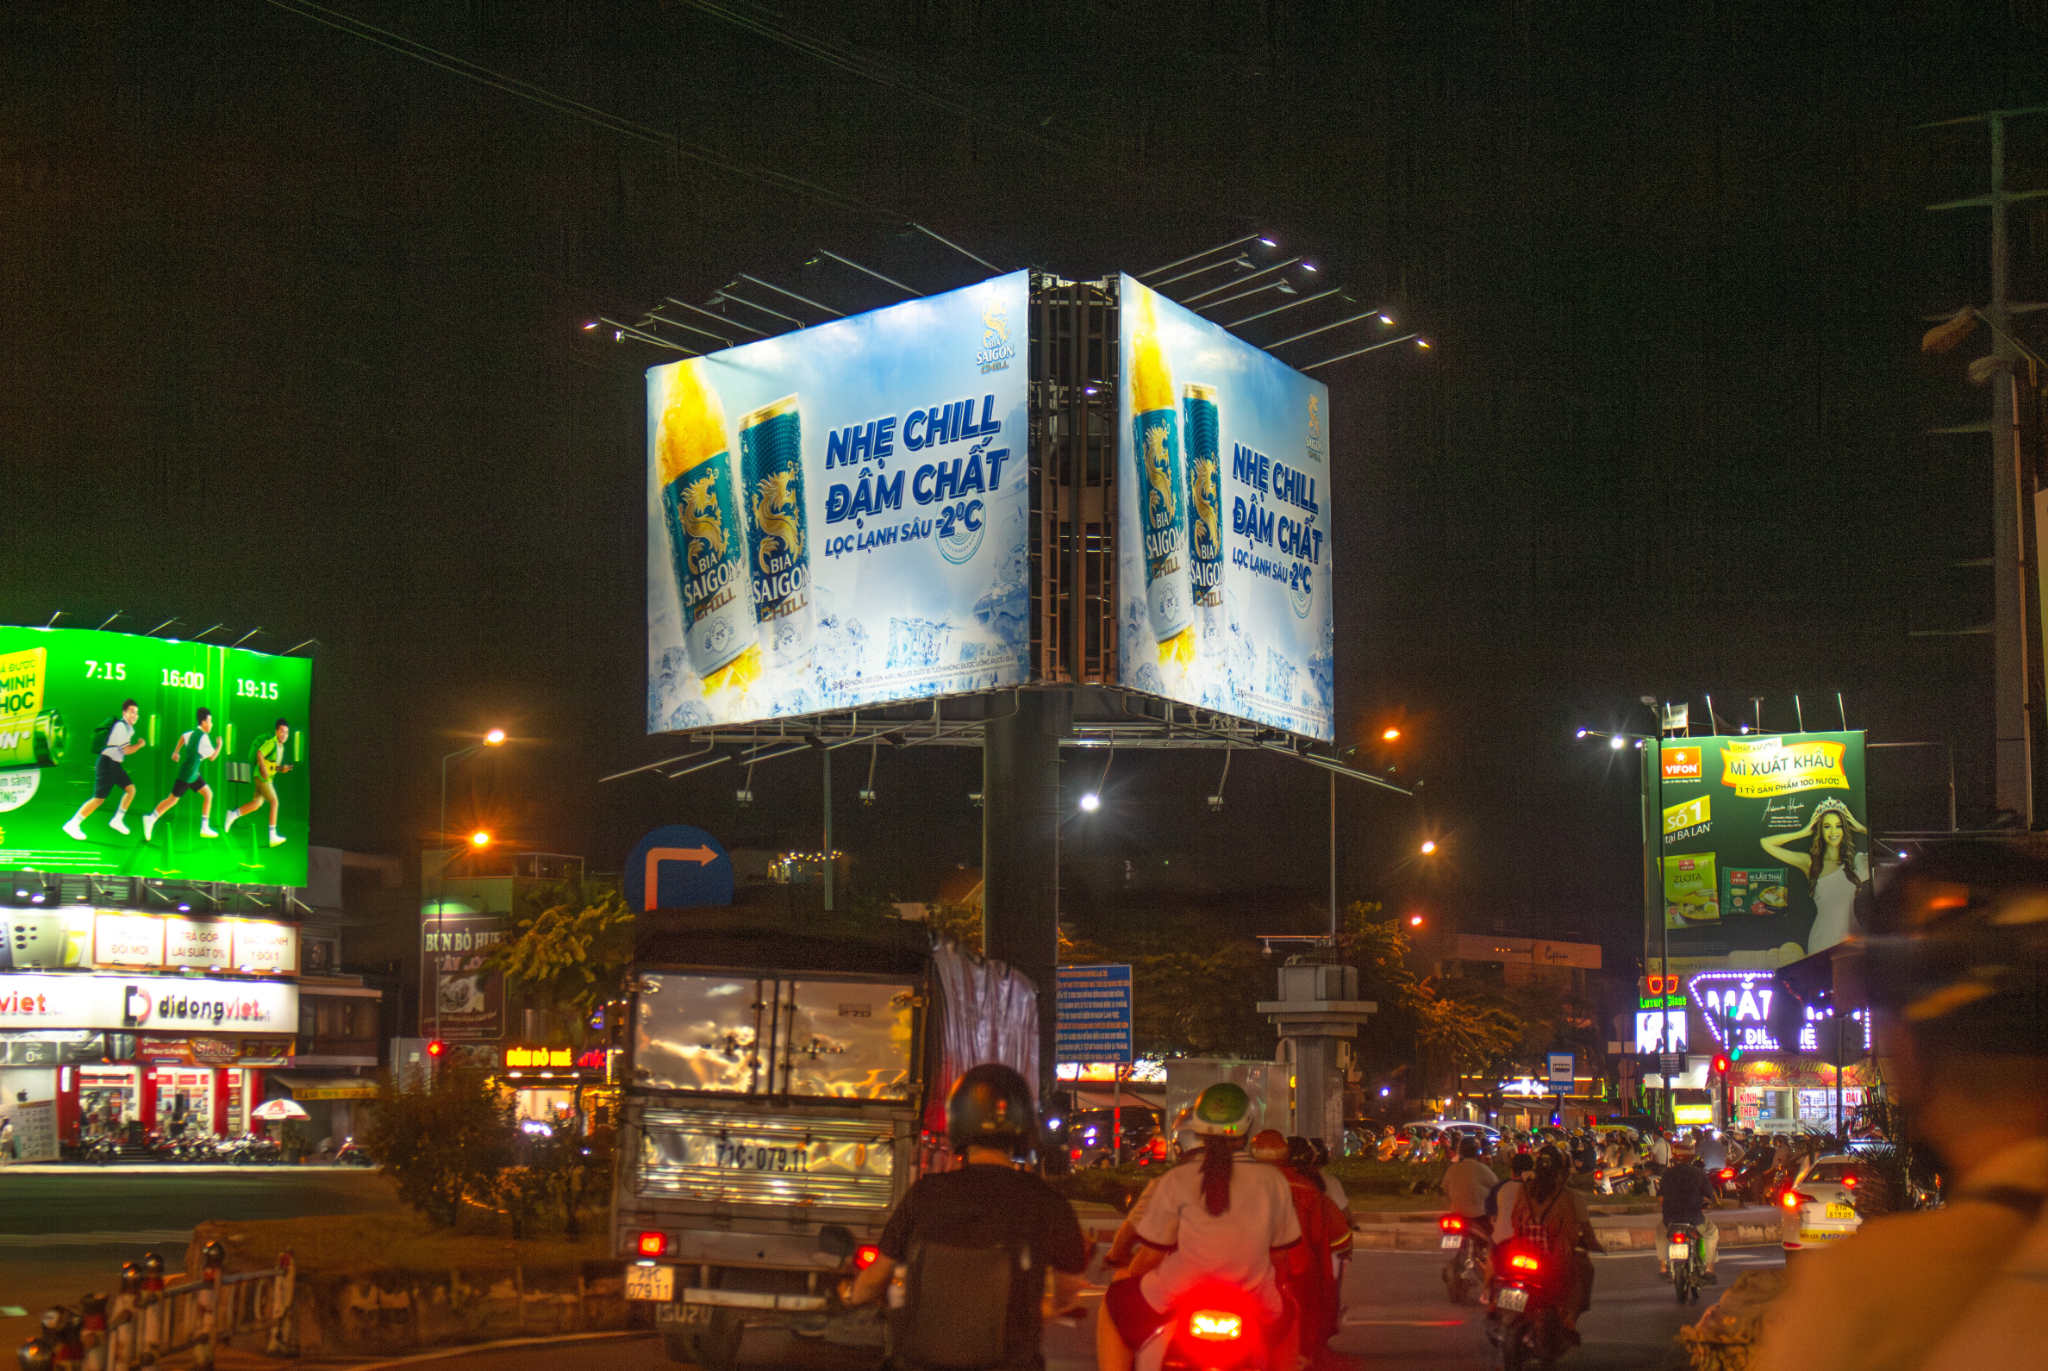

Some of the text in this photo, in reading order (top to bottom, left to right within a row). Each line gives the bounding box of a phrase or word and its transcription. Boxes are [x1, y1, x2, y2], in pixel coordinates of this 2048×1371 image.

[976, 344, 1014, 365] SAIGON
[981, 360, 1009, 374] CHILL
[825, 394, 1002, 470] NHẸ CHILL
[825, 436, 1011, 530] ĐẬM CHẤT
[1232, 442, 1319, 515] NHẸ CHILL
[1156, 511, 1169, 529] BIA
[1232, 492, 1323, 565] ĐẬM CHẤT
[825, 534, 855, 560] LỌC
[857, 525, 899, 554] LẠNH
[901, 516, 933, 542] SÂU
[1146, 526, 1182, 561] SAIGON
[1201, 544, 1214, 560] BIA
[698, 552, 718, 574] BIA
[770, 554, 792, 574] BIA
[1152, 556, 1180, 579] CHILL
[1190, 559, 1224, 587] SAIGON
[1232, 546, 1249, 571] LỌC
[1249, 553, 1272, 578] LẠNH
[1272, 560, 1289, 584] SÂU
[684, 557, 741, 607] SAIGON
[753, 563, 811, 604] SAIGON
[694, 587, 736, 622] CHILL
[761, 593, 808, 623] CHILL
[1195, 590, 1223, 608] CHILL
[85, 660, 279, 700] 7:15 16:00 19:15
[1665, 764, 1698, 775] VIFON
[1730, 747, 1834, 776] MÌ XUẤT KHẨU
[1739, 786, 1744, 794] 1
[1775, 778, 1798, 791] PHẨM
[1800, 778, 1814, 787] 100
[1816, 775, 1840, 785] NƯỚC
[1667, 801, 1702, 830] SỐ 1
[1665, 833, 1676, 845] tại
[1677, 828, 1690, 841] BA
[454, 927, 472, 951] BÒ
[1740, 1106, 1758, 1117] THEO
